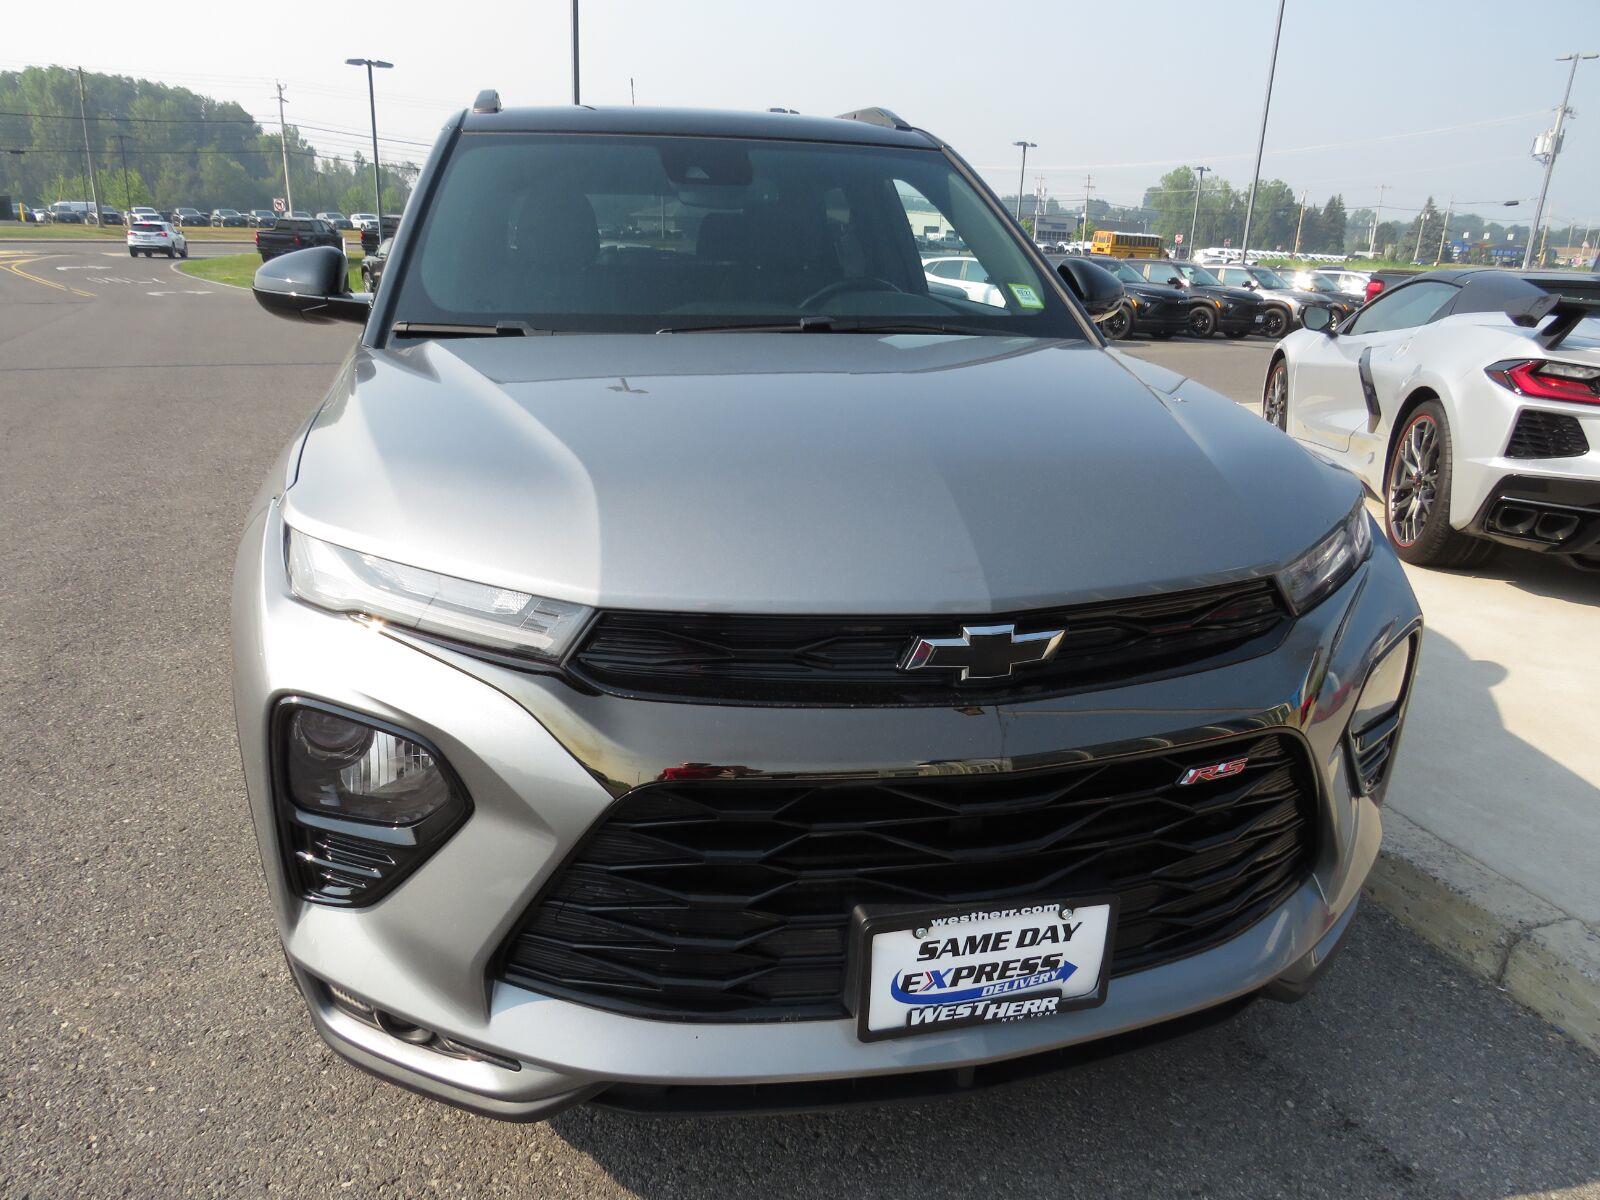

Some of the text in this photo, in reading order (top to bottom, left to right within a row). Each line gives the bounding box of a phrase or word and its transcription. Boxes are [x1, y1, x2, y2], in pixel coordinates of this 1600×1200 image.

[1180, 757, 1249, 785] RS
[931, 903, 1060, 928] westherr.com
[916, 921, 1083, 962] SAME DAY
[900, 952, 1064, 994] EXPRESS
[981, 970, 1060, 997] DELIVERY
[1001, 1010, 1058, 1022] NEW YORK
